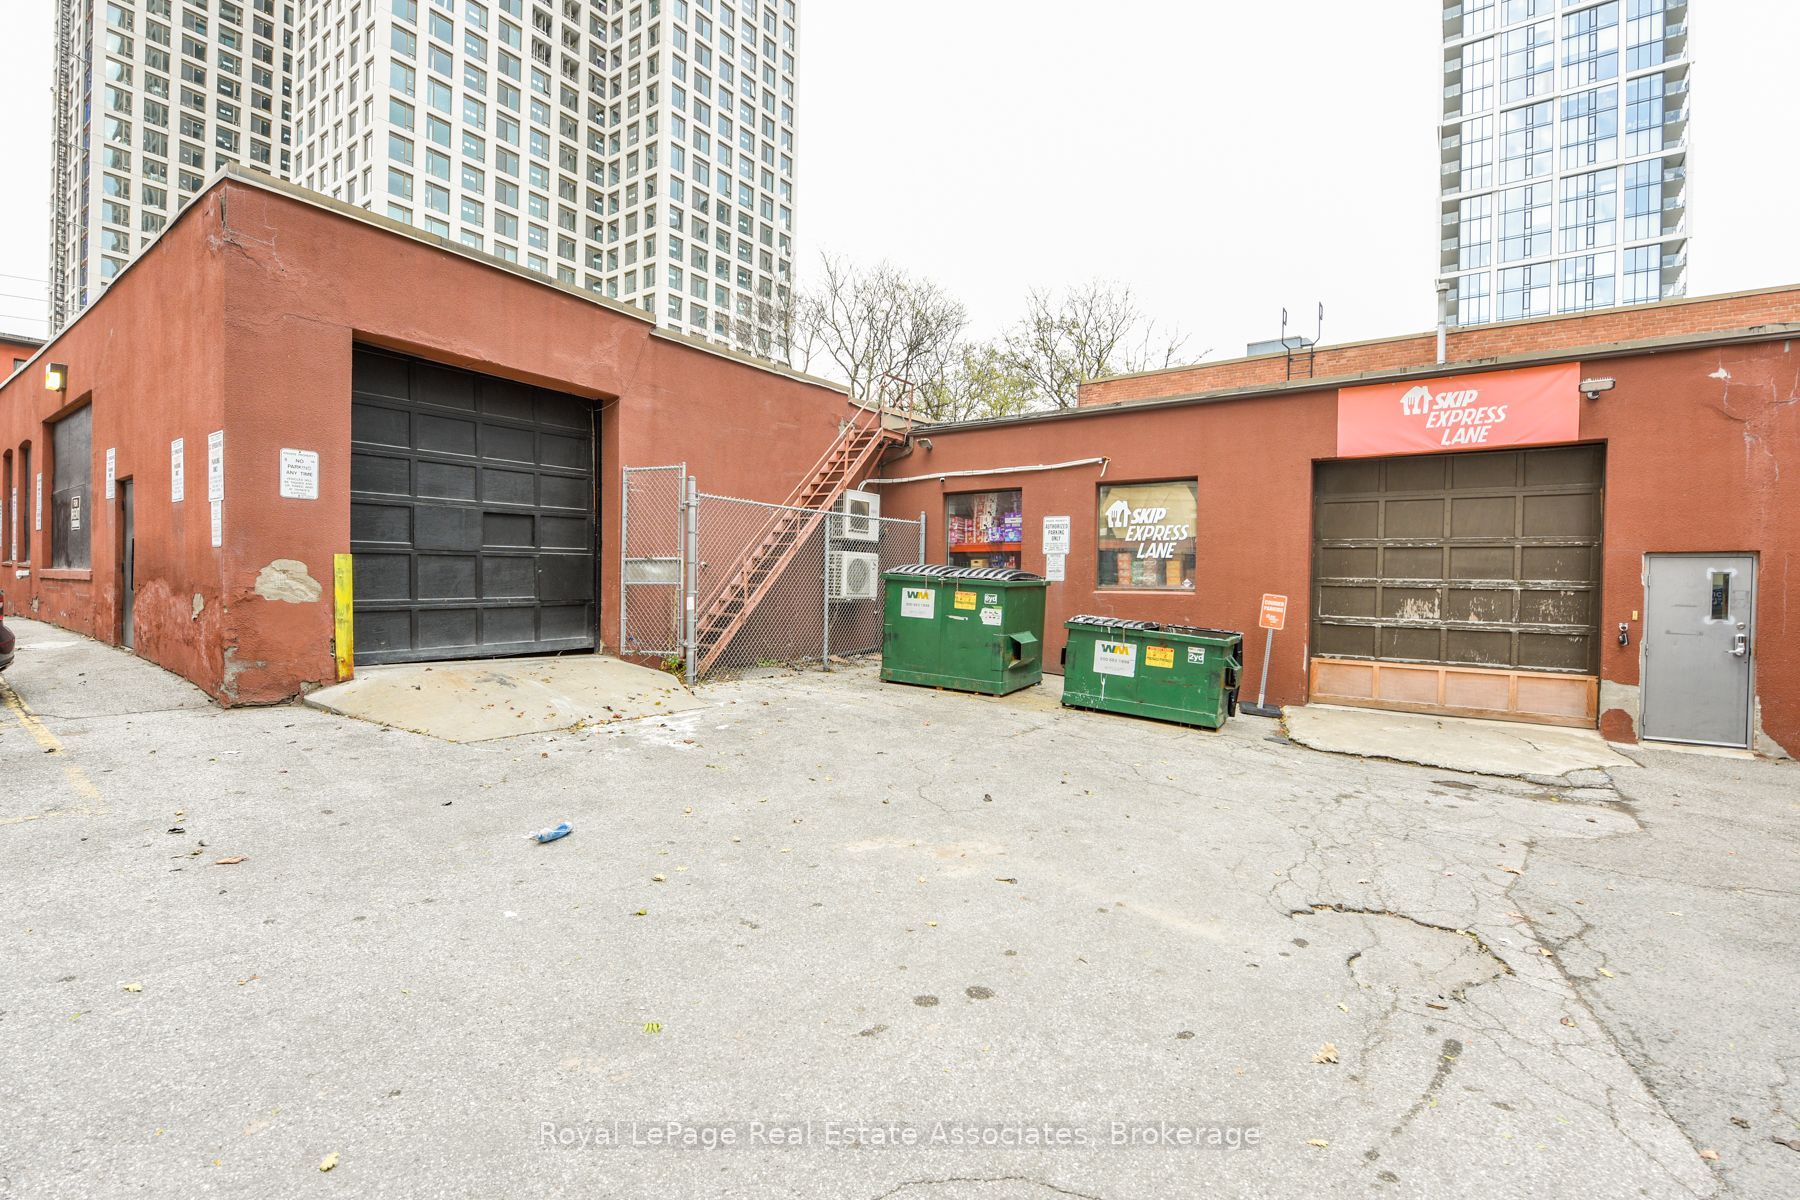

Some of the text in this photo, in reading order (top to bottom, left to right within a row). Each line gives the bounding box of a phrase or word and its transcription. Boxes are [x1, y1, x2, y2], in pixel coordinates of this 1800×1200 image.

[1432, 389, 1479, 410] SKIP
[1426, 405, 1508, 429] EXPRESS
[1441, 425, 1492, 446] LANE
[287, 463, 312, 471] PARKING
[1130, 507, 1168, 525] SKIP
[1125, 524, 1189, 542] EXPRESS
[1136, 542, 1177, 559] LANE
[907, 591, 929, 600] WM
[1101, 643, 1129, 656] WM
